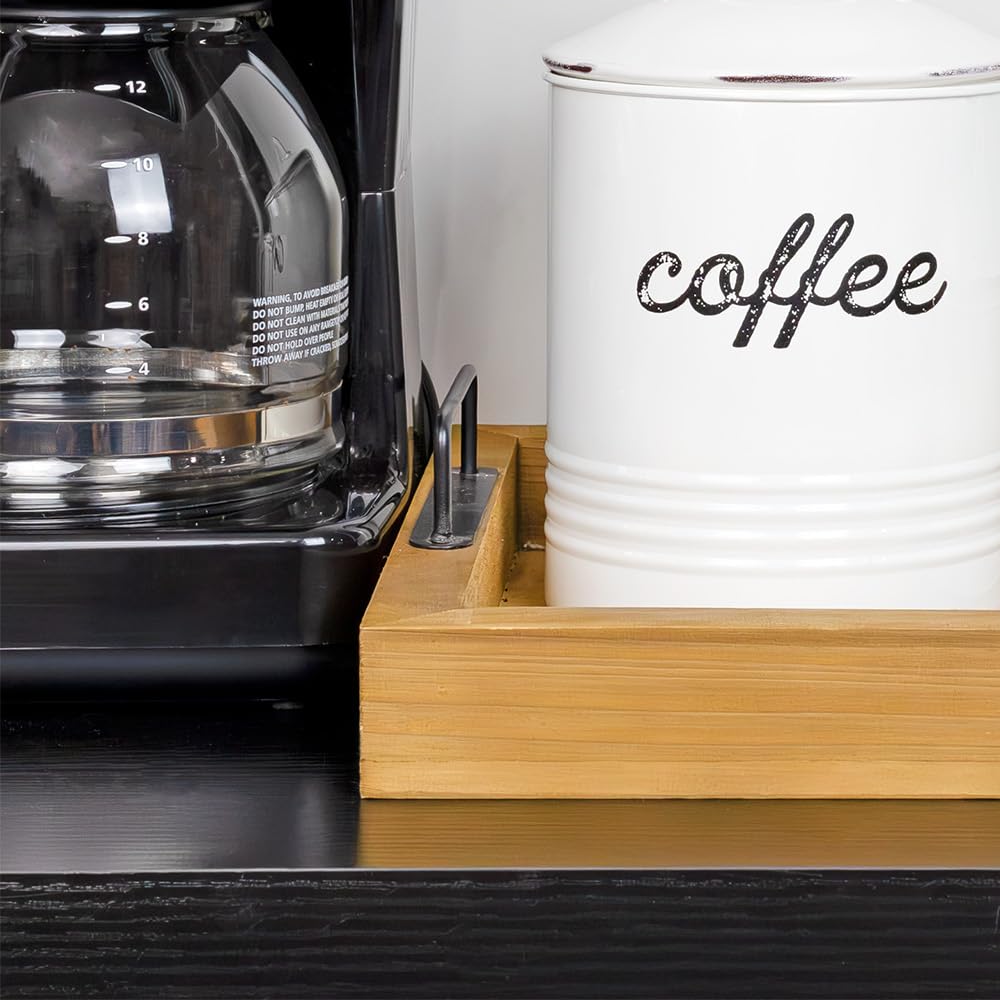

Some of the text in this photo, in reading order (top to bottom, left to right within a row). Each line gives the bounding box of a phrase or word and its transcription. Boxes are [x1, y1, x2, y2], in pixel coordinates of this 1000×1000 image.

[125, 80, 147, 93] 12
[132, 157, 154, 171] 10
[137, 232, 149, 246] 8
[637, 213, 948, 349] coffee
[293, 291, 302, 301] TO
[303, 287, 320, 300] AVOID
[138, 298, 149, 311] 6
[252, 309, 266, 320] DO
[267, 306, 284, 318] NOT
[305, 299, 319, 310] HEAT
[252, 321, 266, 332] DO
[267, 318, 284, 329] NOT
[285, 314, 306, 326] CLEAN
[306, 311, 320, 322] WITH
[252, 333, 266, 344] DO
[267, 330, 284, 341] NOT
[285, 327, 298, 338] USE
[298, 326, 309, 336] ON
[309, 323, 321, 334] ANY
[252, 345, 266, 356] DO
[267, 342, 284, 353] NOT
[284, 338, 303, 350] HOLD
[303, 335, 318, 346] OVER
[251, 354, 283, 368] THROW
[283, 350, 304, 363] AWAY
[304, 348, 310, 358] IF
[138, 365, 150, 376] 4
